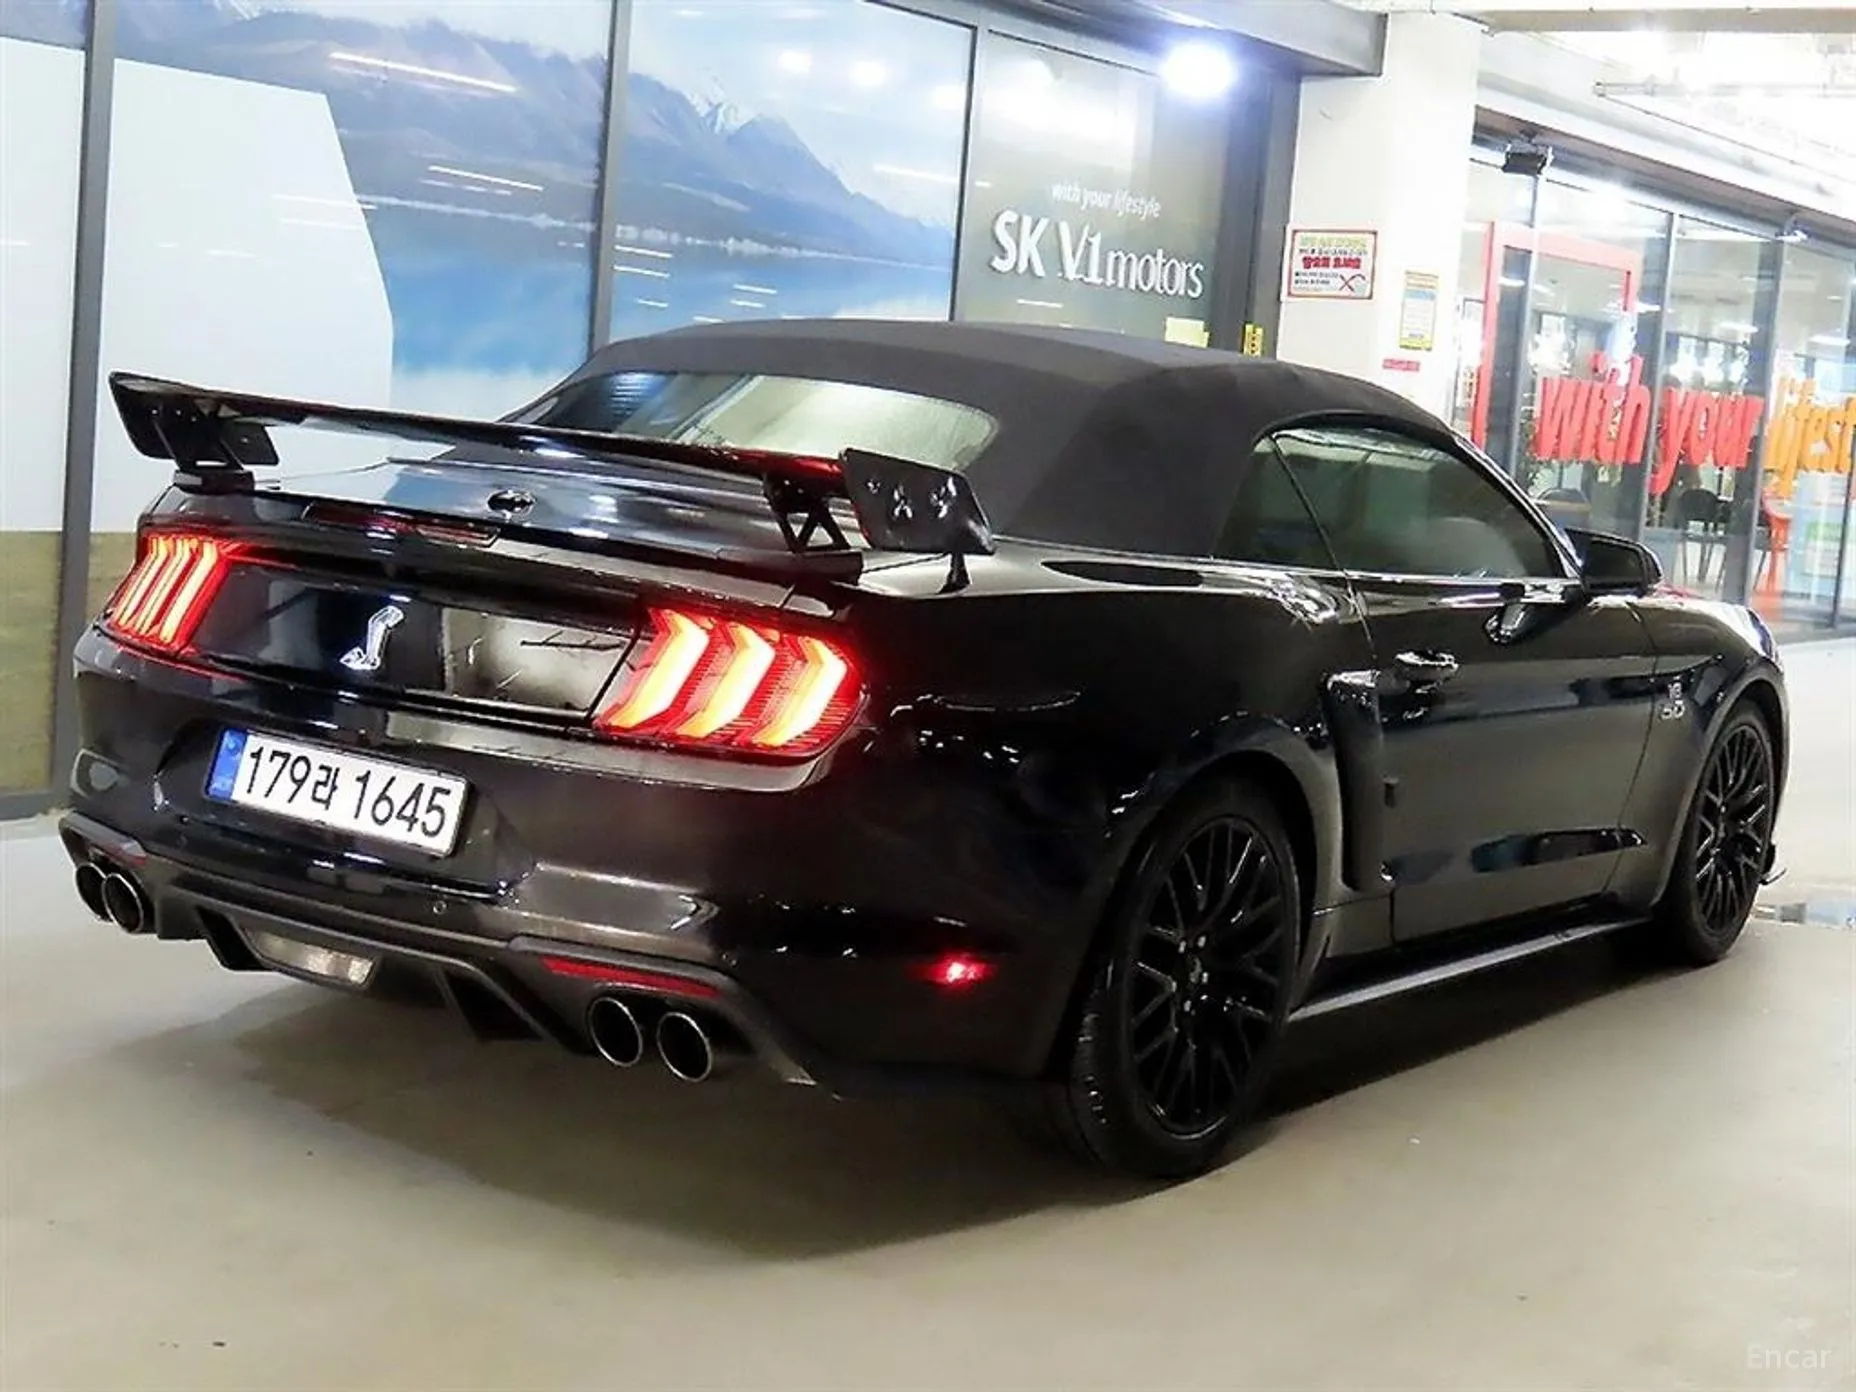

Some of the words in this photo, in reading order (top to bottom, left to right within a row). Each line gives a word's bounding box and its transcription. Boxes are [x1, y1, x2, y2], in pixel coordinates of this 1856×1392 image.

[1052, 180, 1081, 203] with
[1080, 188, 1112, 211] your
[1112, 188, 1161, 220] lifestyle
[991, 210, 1050, 277] SK
[1533, 351, 1650, 464] with
[1648, 386, 1764, 495] your
[246, 746, 340, 811] 179라
[354, 770, 452, 837] 1645
